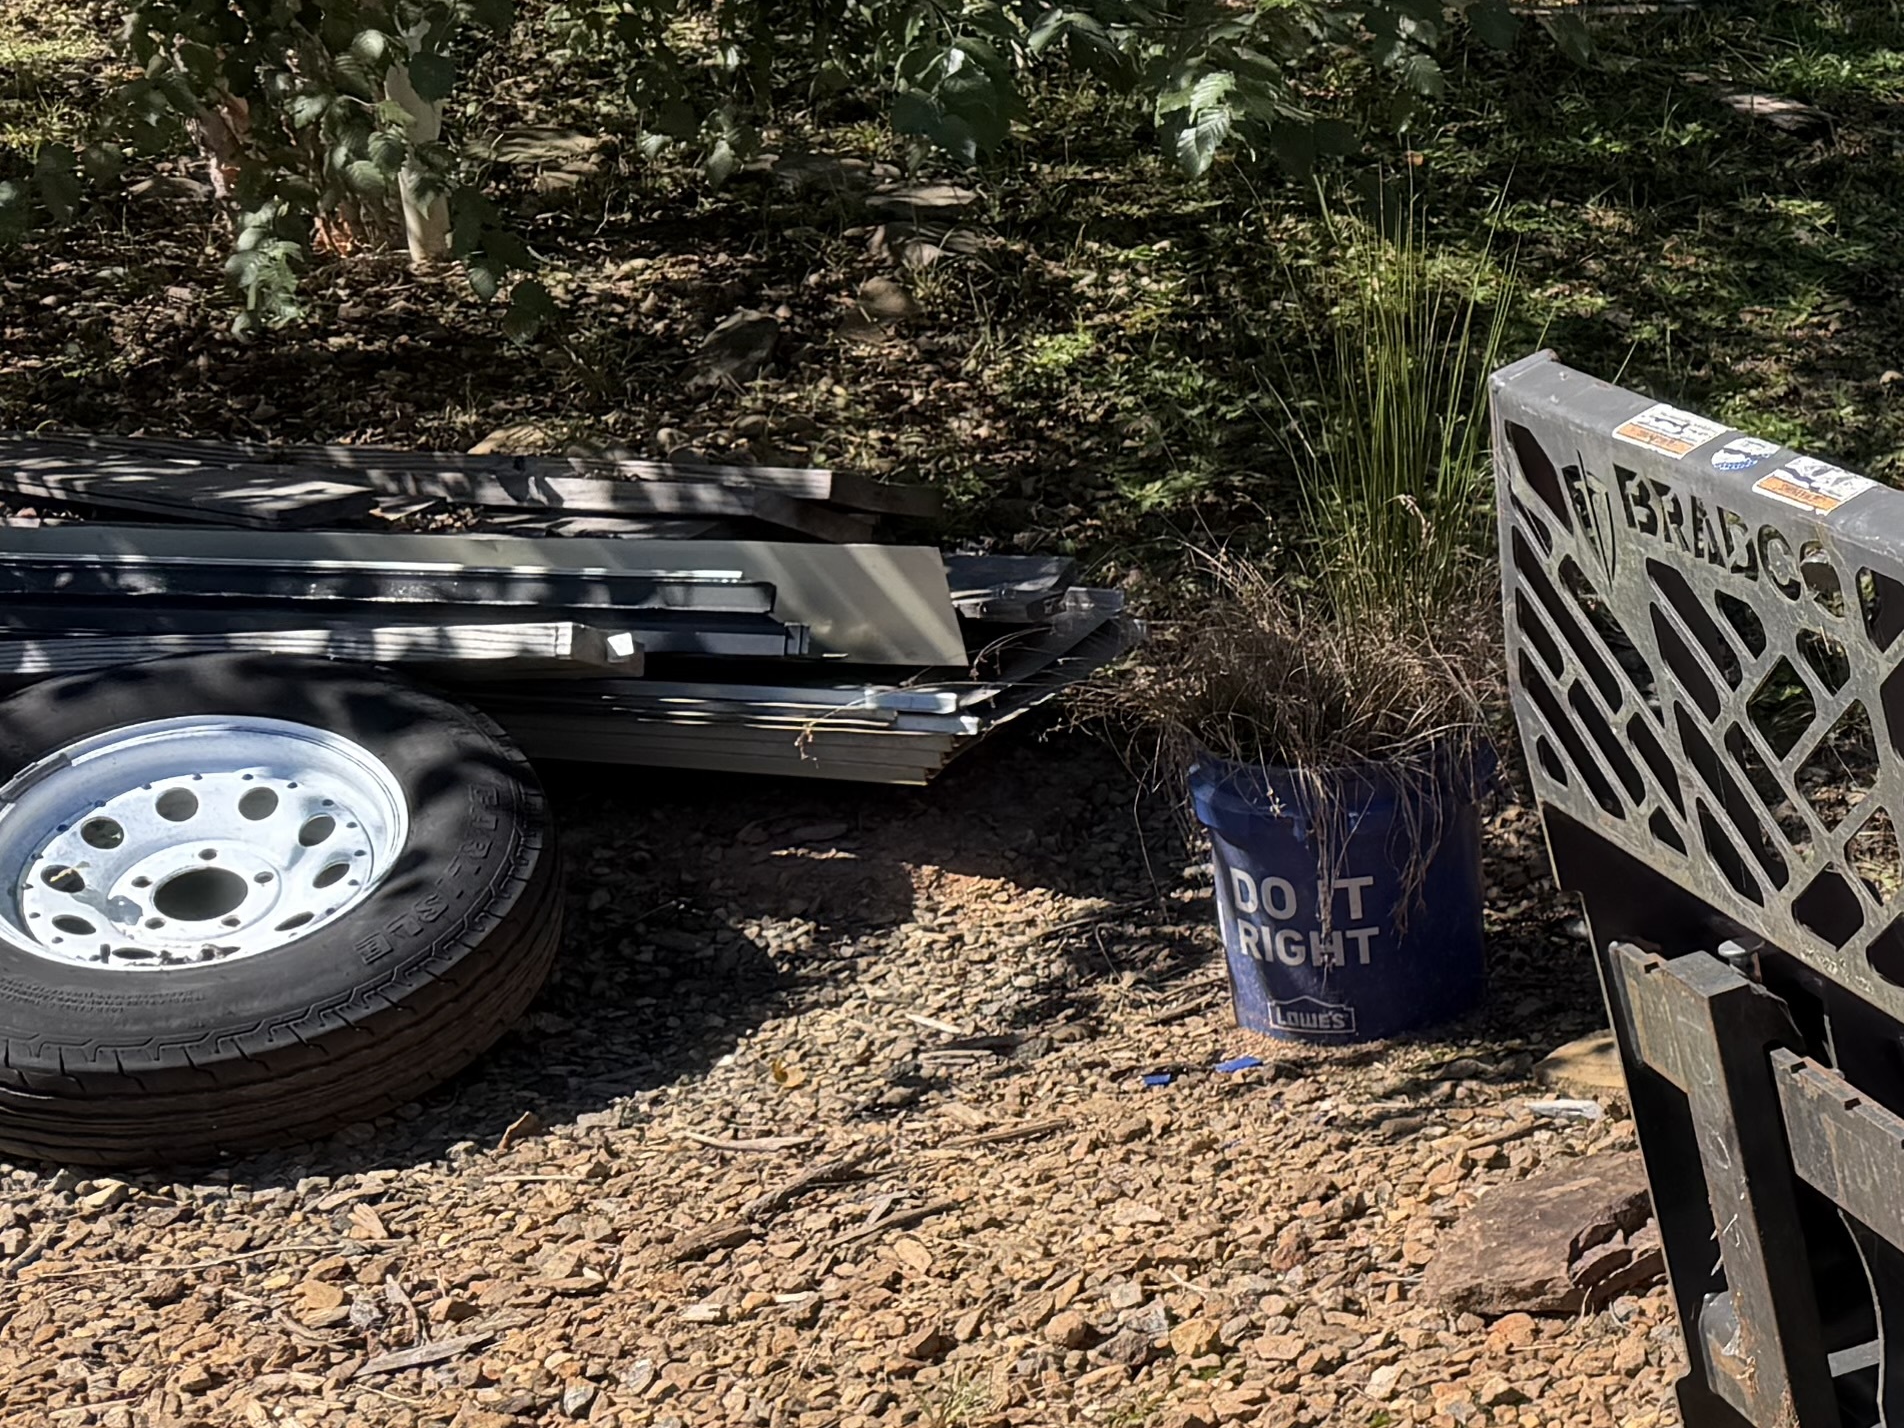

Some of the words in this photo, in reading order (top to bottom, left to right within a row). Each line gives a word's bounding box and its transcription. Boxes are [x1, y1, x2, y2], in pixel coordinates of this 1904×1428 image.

[1614, 463, 1846, 620] BRADCO
[1230, 867, 1297, 920] DO
[1237, 922, 1380, 968] RIGHT
